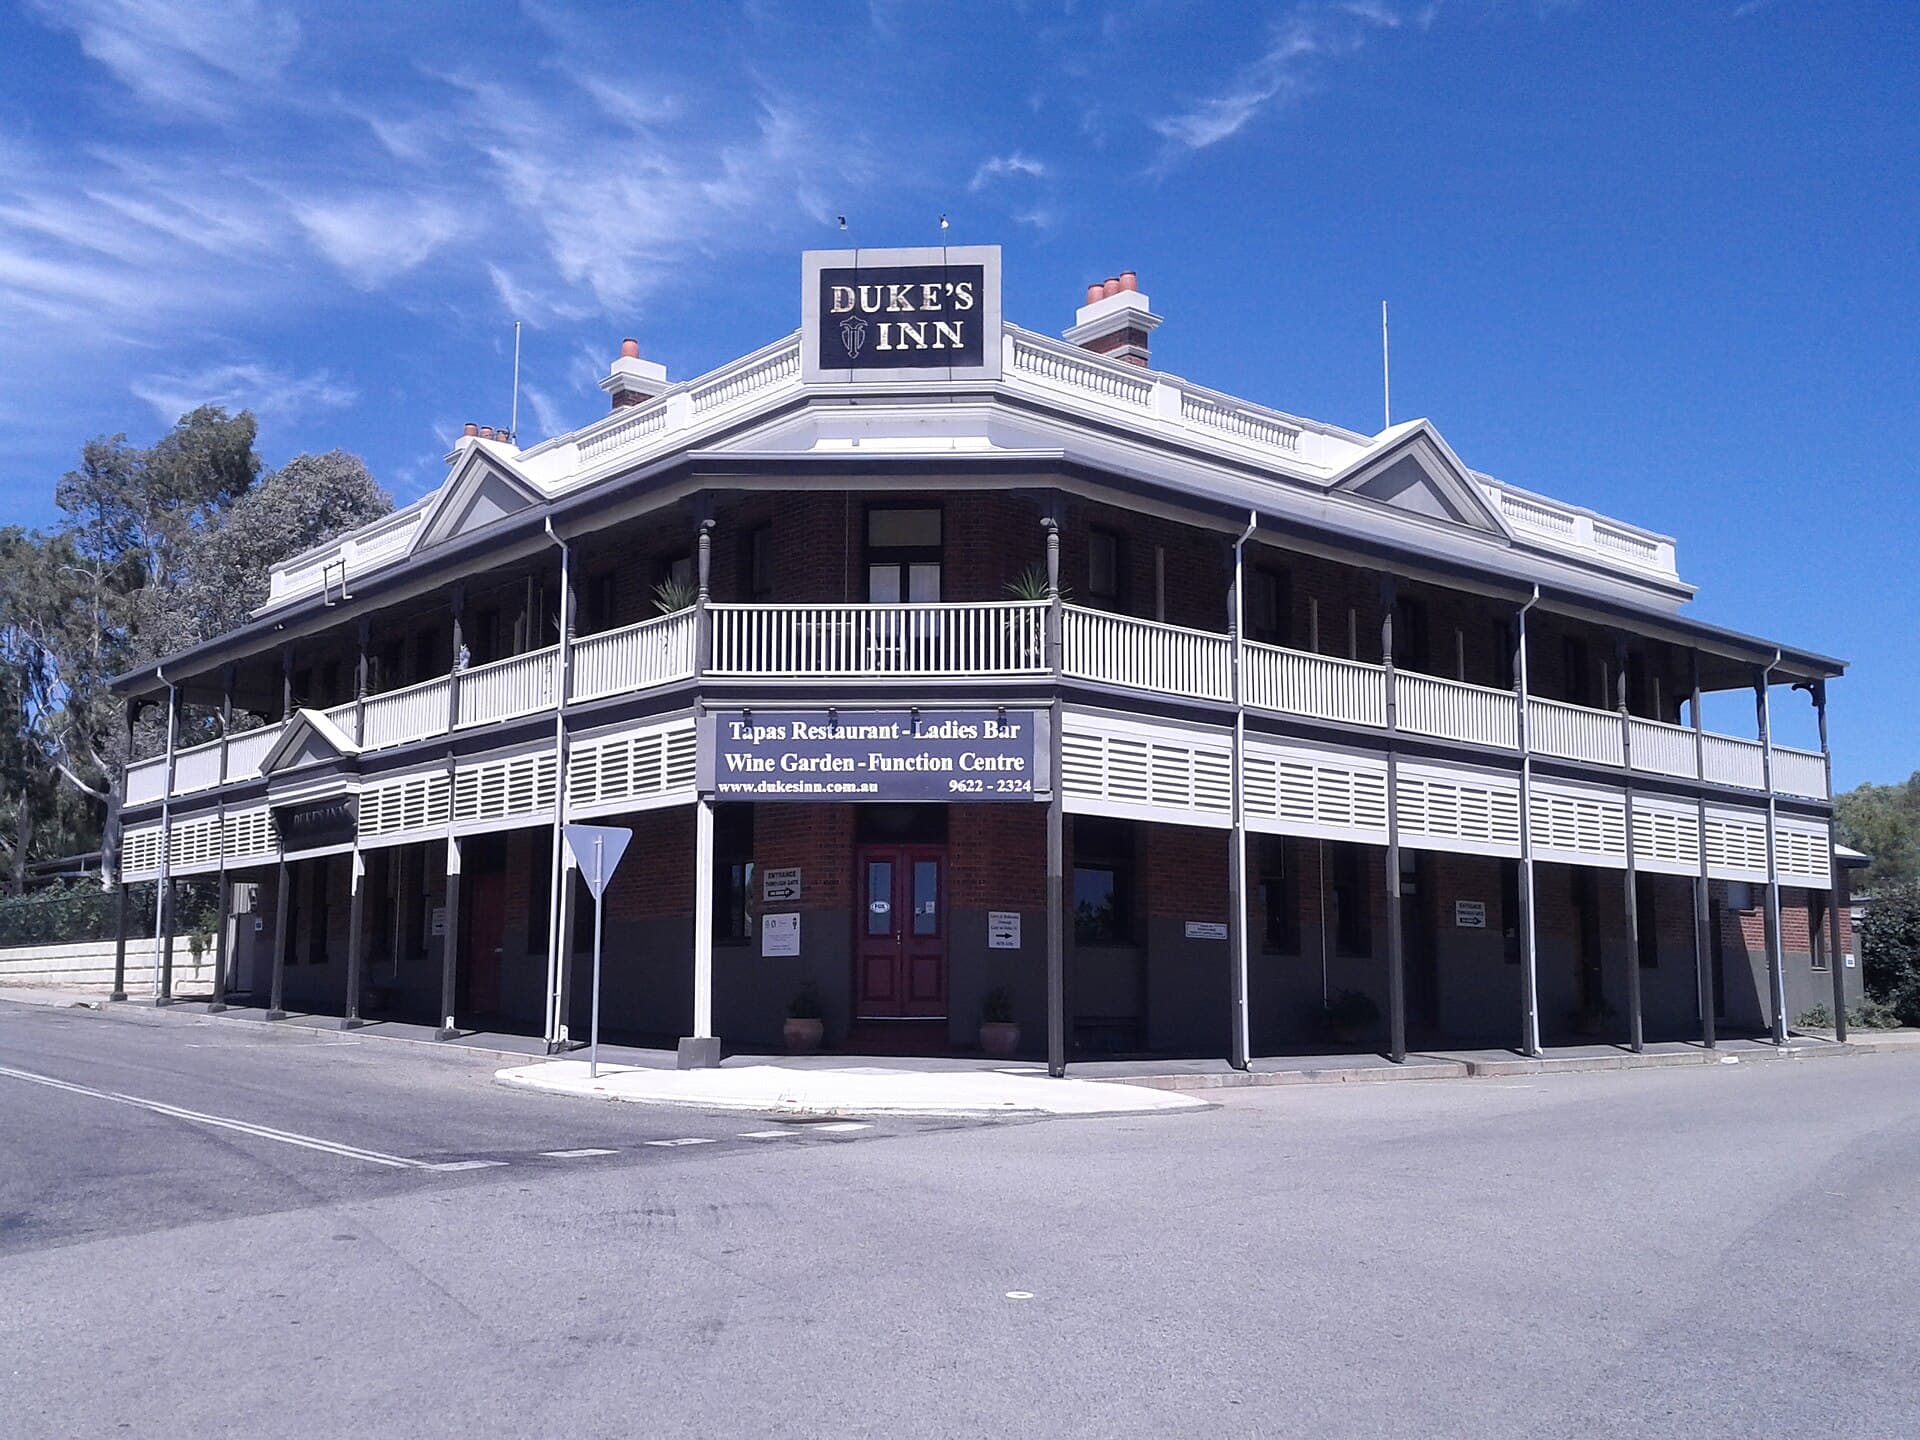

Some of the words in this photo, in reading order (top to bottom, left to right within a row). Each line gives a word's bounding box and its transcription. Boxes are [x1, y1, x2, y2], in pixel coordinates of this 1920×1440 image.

[830, 282, 974, 313] DUKE'S
[876, 321, 964, 350] INN
[729, 721, 786, 745] Tapas
[791, 721, 899, 740] Restaurant
[913, 720, 978, 739] Ladies
[983, 720, 1021, 739] Bar
[724, 753, 775, 772] Wine
[780, 753, 854, 772] Garden
[867, 752, 953, 772] Function
[959, 752, 1025, 771] Centre
[717, 780, 879, 793] www.dukesinn.com.au
[949, 780, 983, 793] 9622
[997, 780, 1032, 793] 2324
